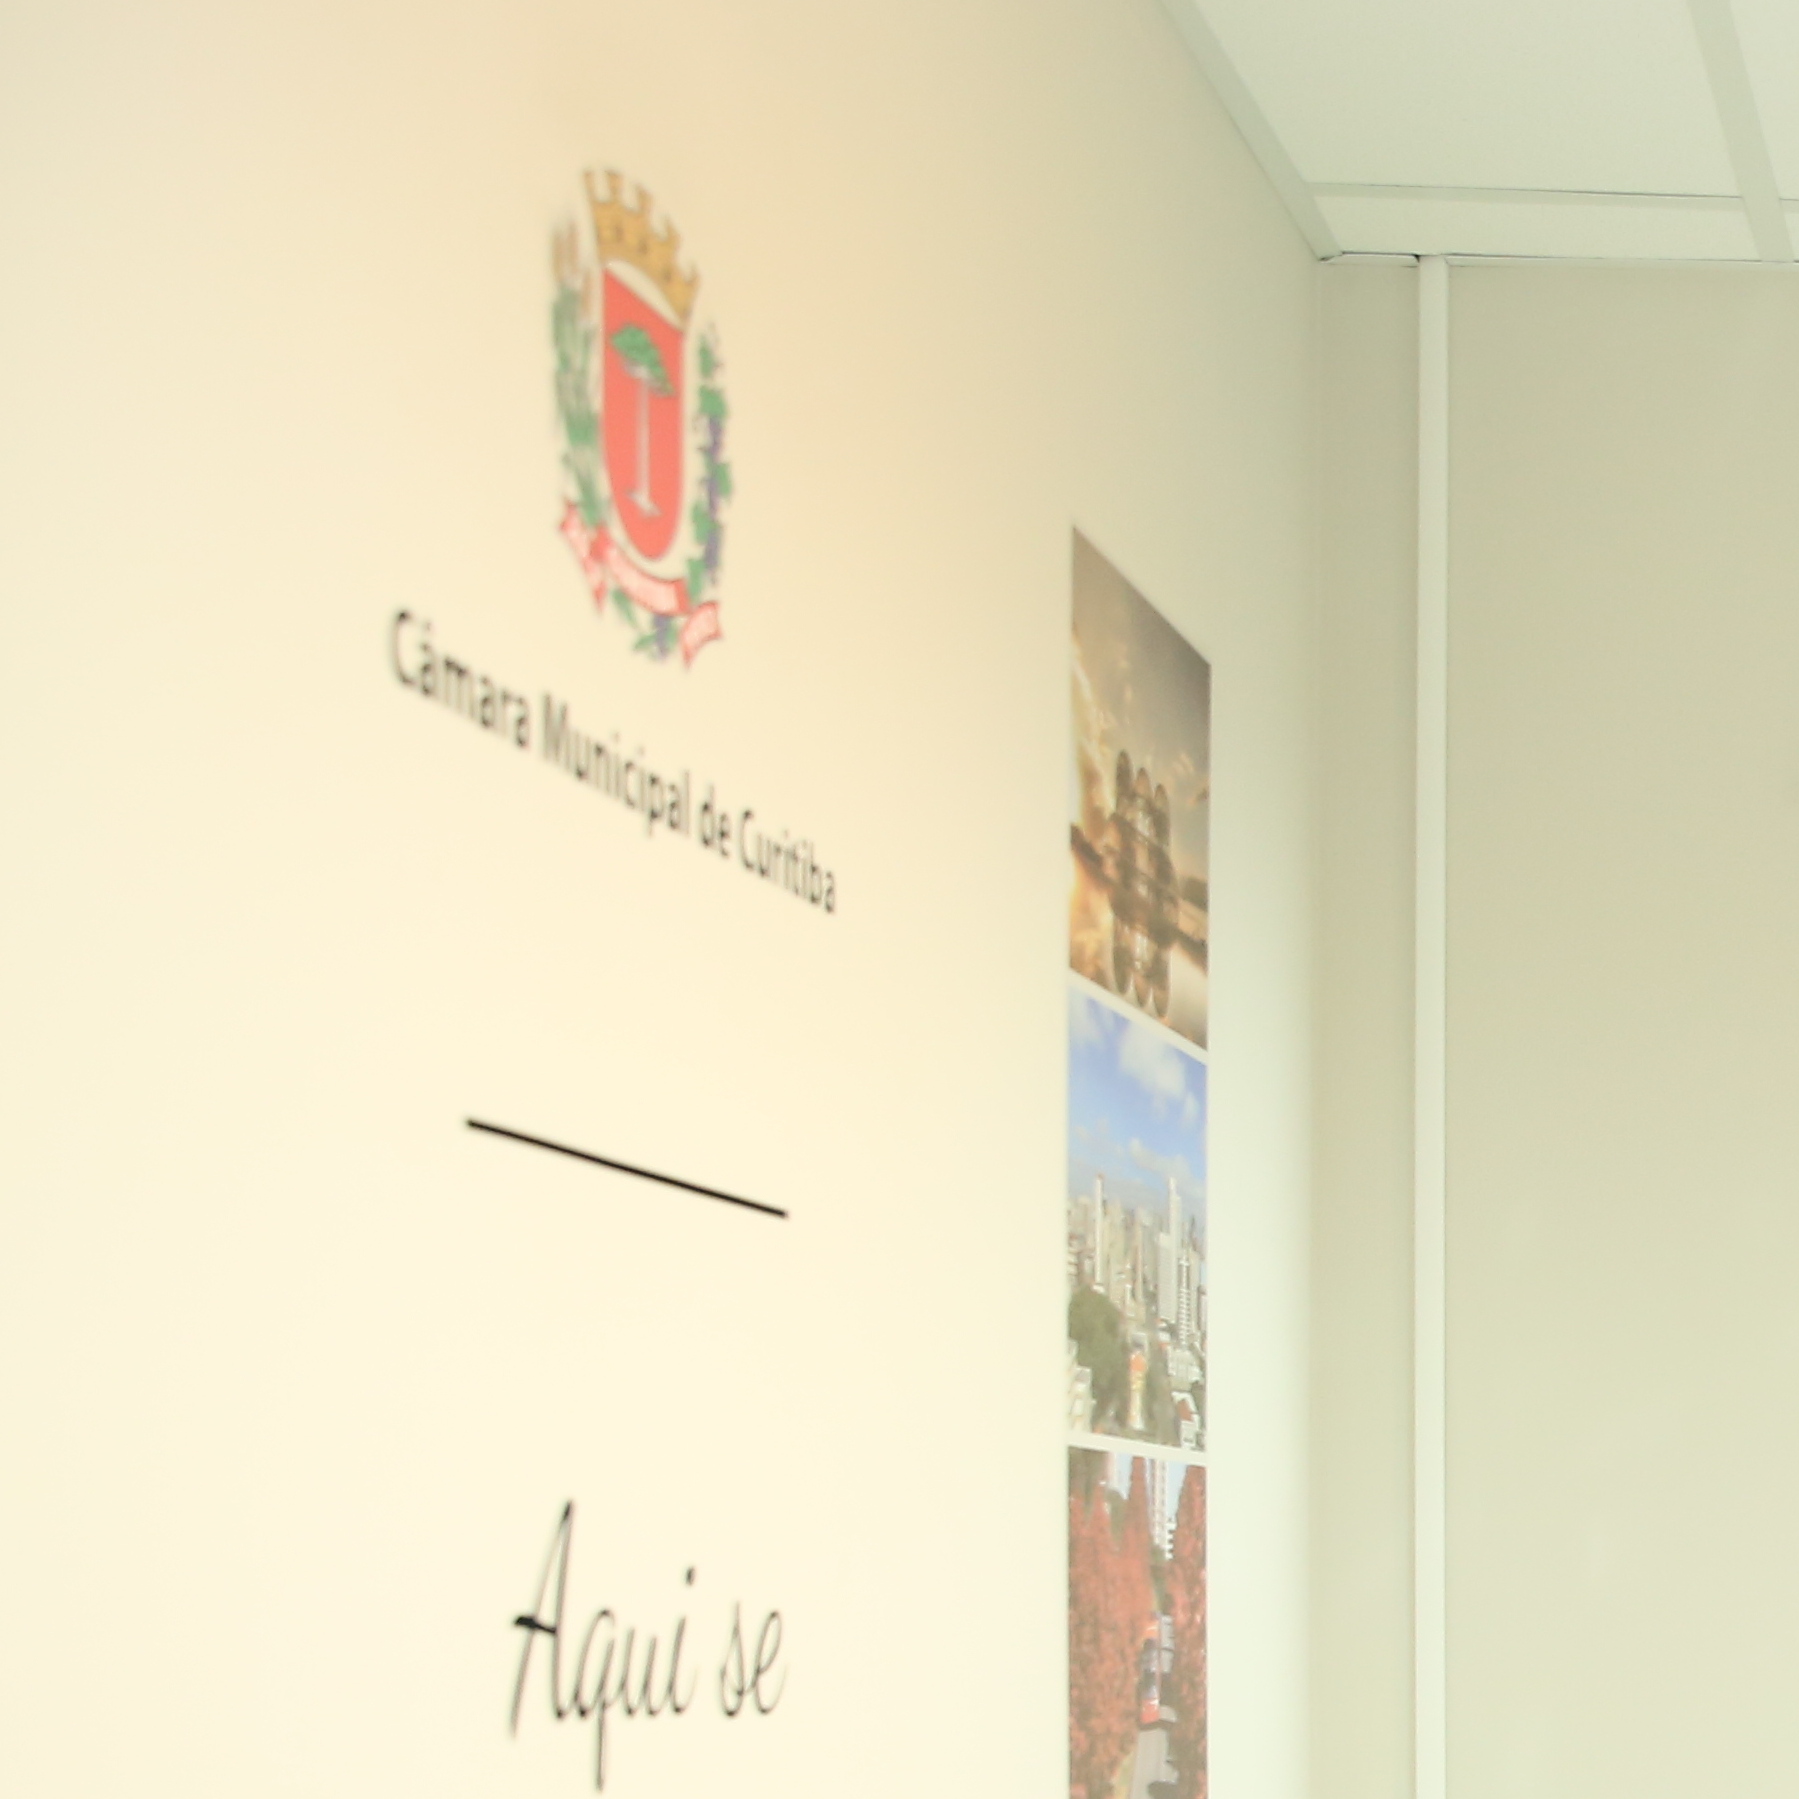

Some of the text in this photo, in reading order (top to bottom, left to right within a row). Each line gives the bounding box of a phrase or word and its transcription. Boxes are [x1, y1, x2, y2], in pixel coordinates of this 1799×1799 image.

[391, 608, 836, 915] Câmara Municipal de Curitiba
[508, 1498, 784, 1794] Aqui se
